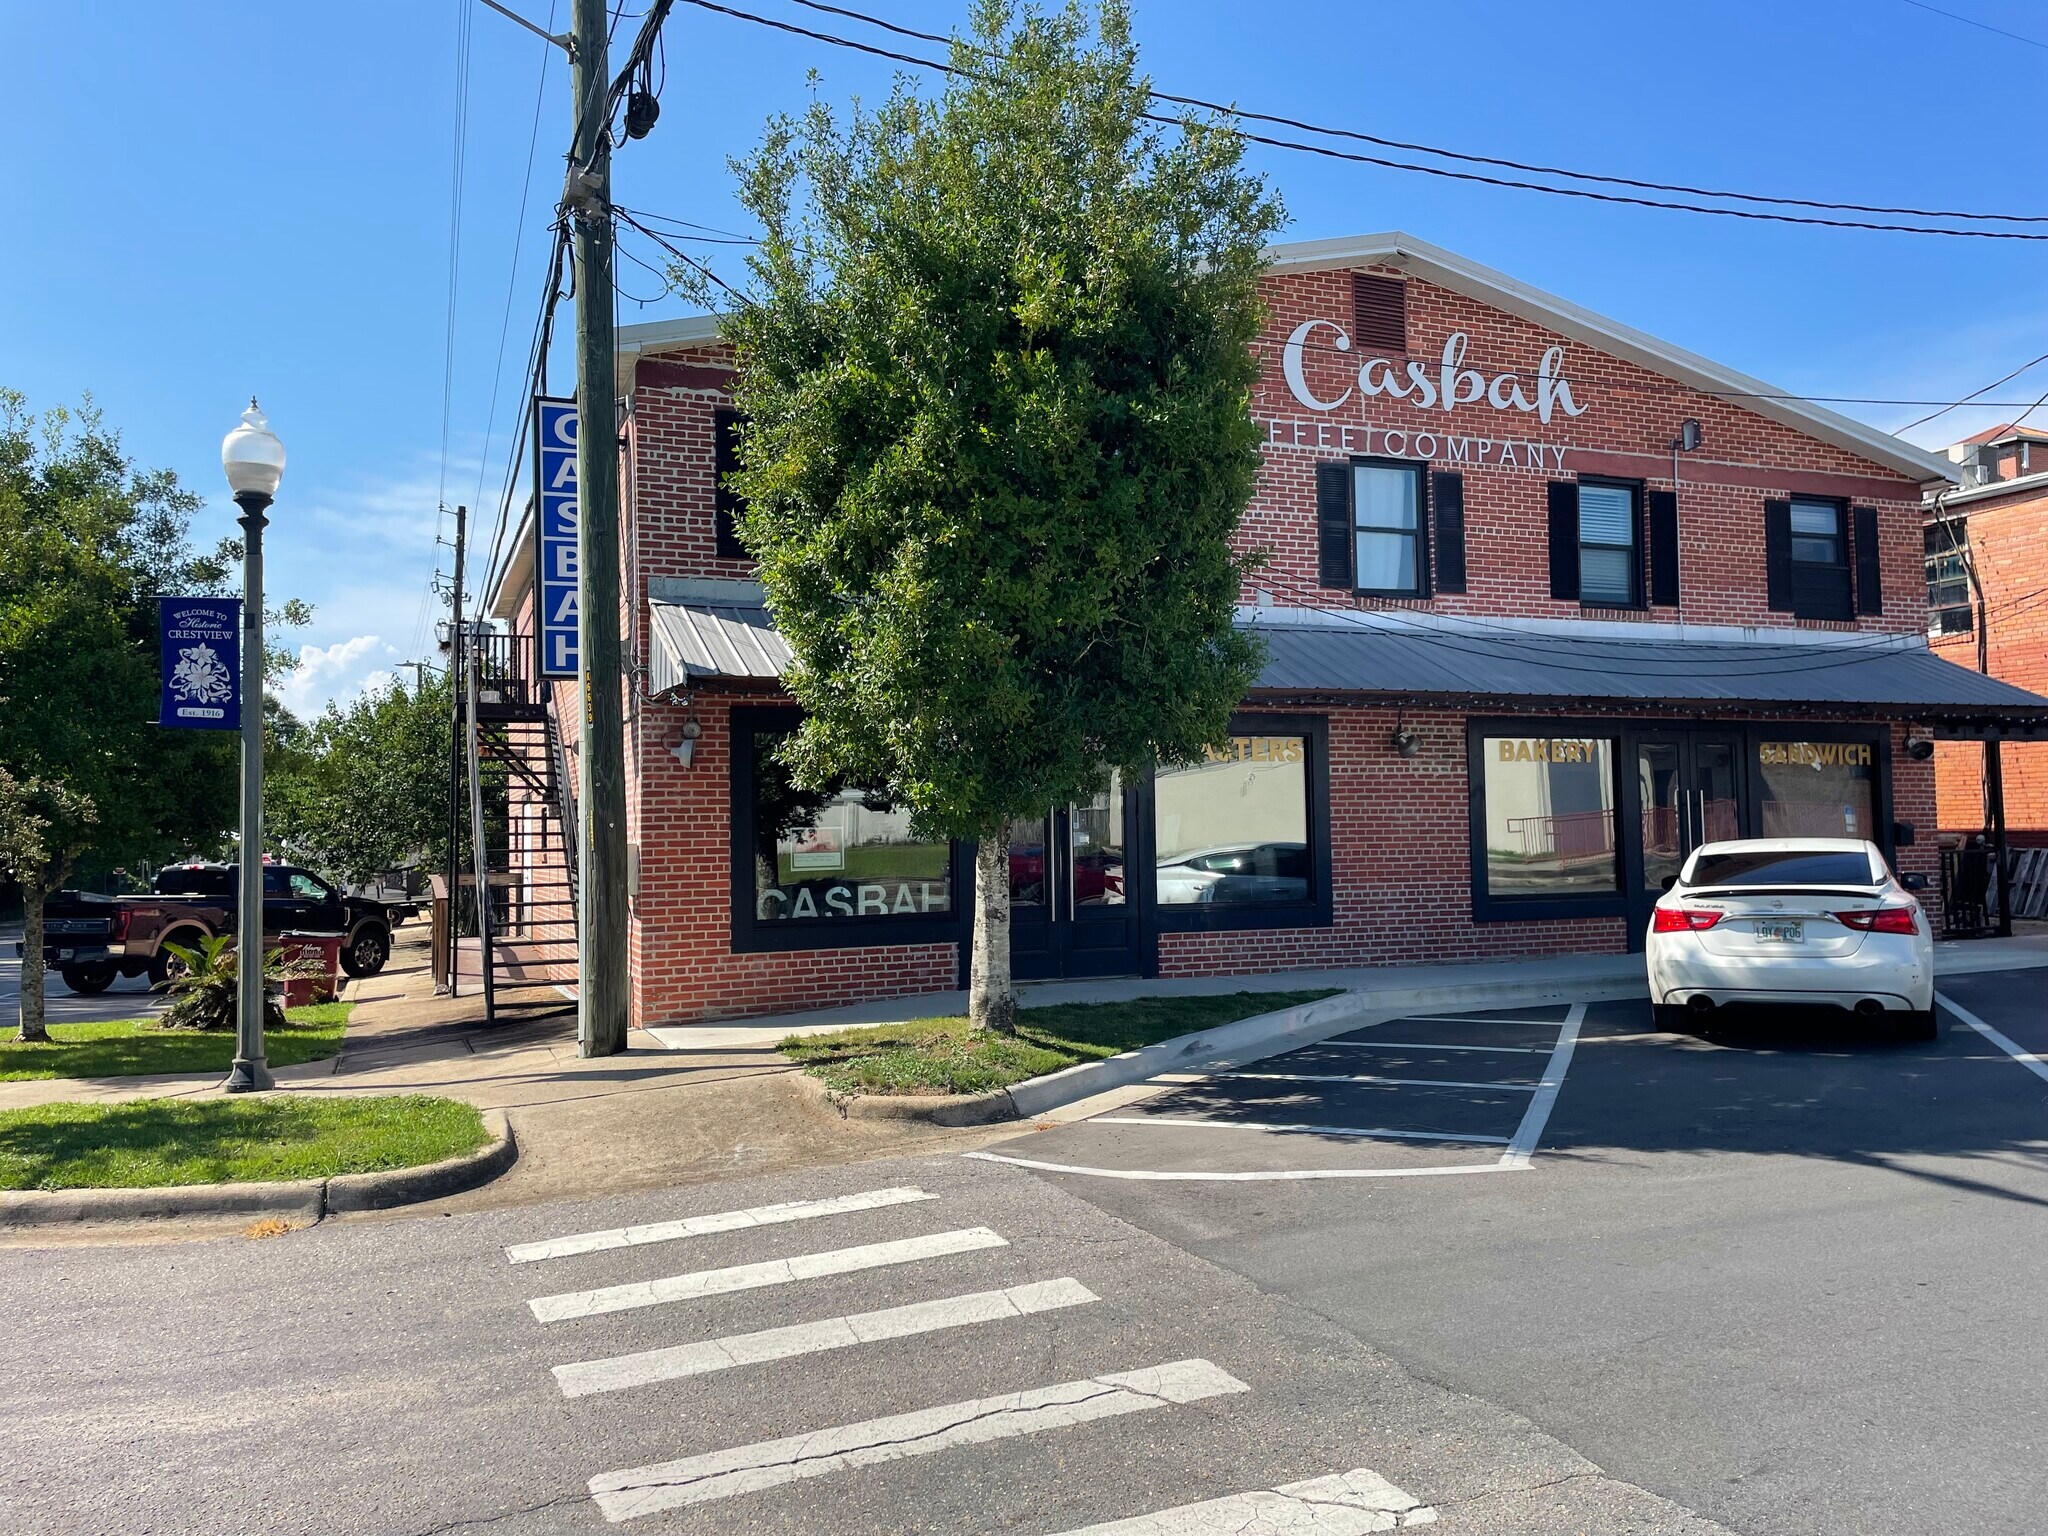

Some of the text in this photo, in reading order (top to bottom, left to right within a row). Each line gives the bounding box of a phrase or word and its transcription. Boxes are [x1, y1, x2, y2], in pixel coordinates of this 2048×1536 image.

[1282, 319, 1589, 425] Casbah
[1268, 419, 1567, 470] FFEE COMPANY
[173, 609, 228, 621] WELCOME TO
[178, 617, 222, 629] Historic
[168, 629, 233, 640] CRESTVIEW
[182, 708, 220, 718] Est. 1916
[1499, 740, 1595, 763] BAKERY
[1759, 743, 1871, 766] SANDWICH
[757, 883, 951, 920] CASBAH
